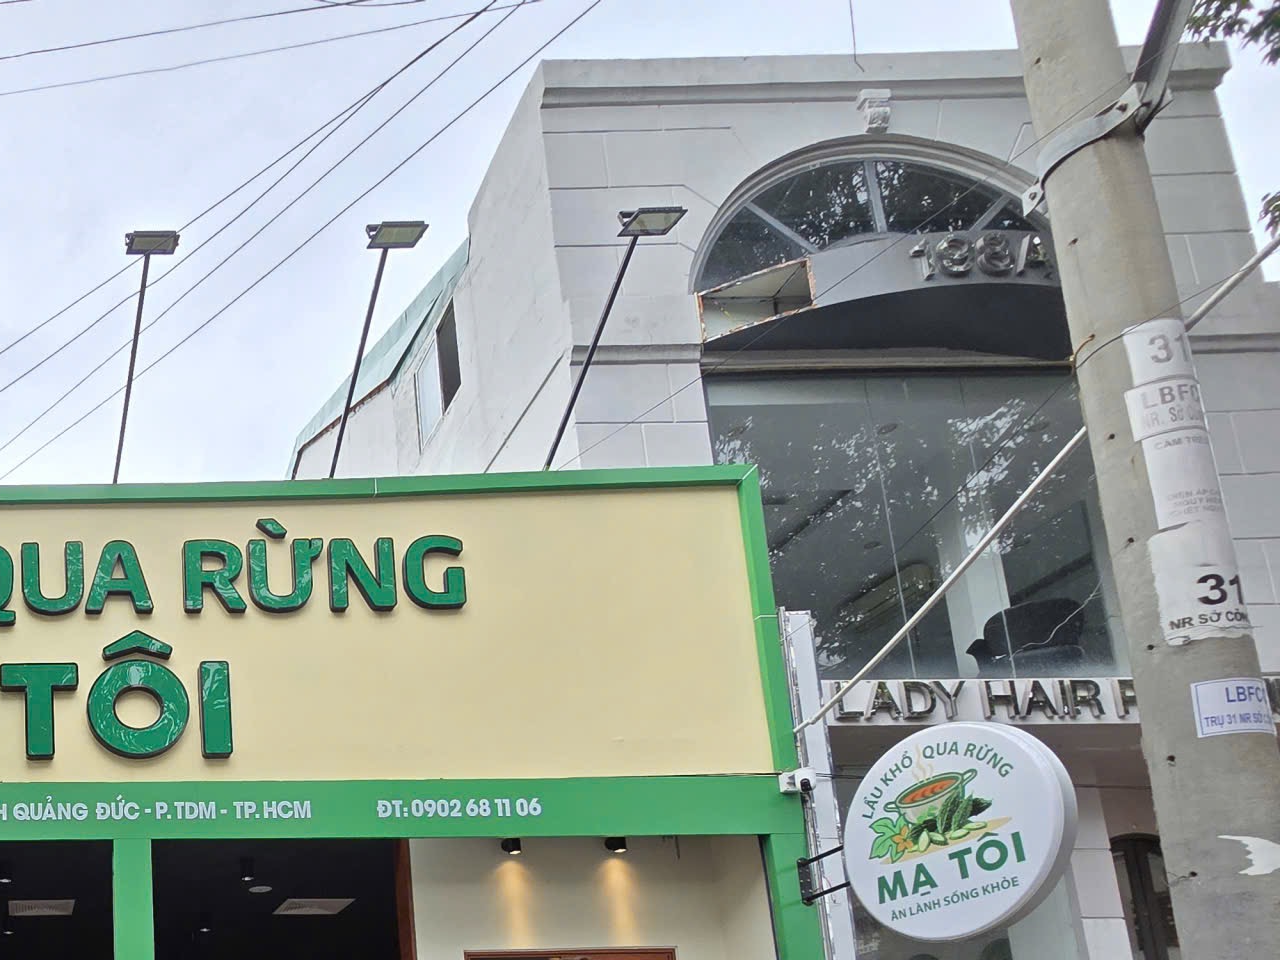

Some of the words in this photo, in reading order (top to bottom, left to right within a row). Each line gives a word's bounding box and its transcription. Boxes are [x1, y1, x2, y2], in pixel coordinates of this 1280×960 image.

[182, 518, 468, 614] RỪNG
[1196, 573, 1244, 606] 31
[1169, 616, 1195, 631] NR
[831, 679, 966, 720] LADY
[979, 678, 1107, 720] HAIR
[1226, 713, 1238, 725] 31
[922, 741, 959, 759] QUA
[963, 742, 1014, 778] RỪNG
[13, 795, 89, 821] QUẢNG
[95, 794, 140, 820] ĐỨC
[412, 798, 462, 818] 0902
[466, 798, 492, 817] 68
[495, 798, 511, 817] 11
[516, 797, 542, 816] 06
[877, 863, 938, 904] MẠ
[948, 831, 1026, 880] TÔI
[909, 898, 941, 916] LÀNH
[943, 888, 980, 906] SỐNG
[982, 876, 1020, 896] KHỎE
